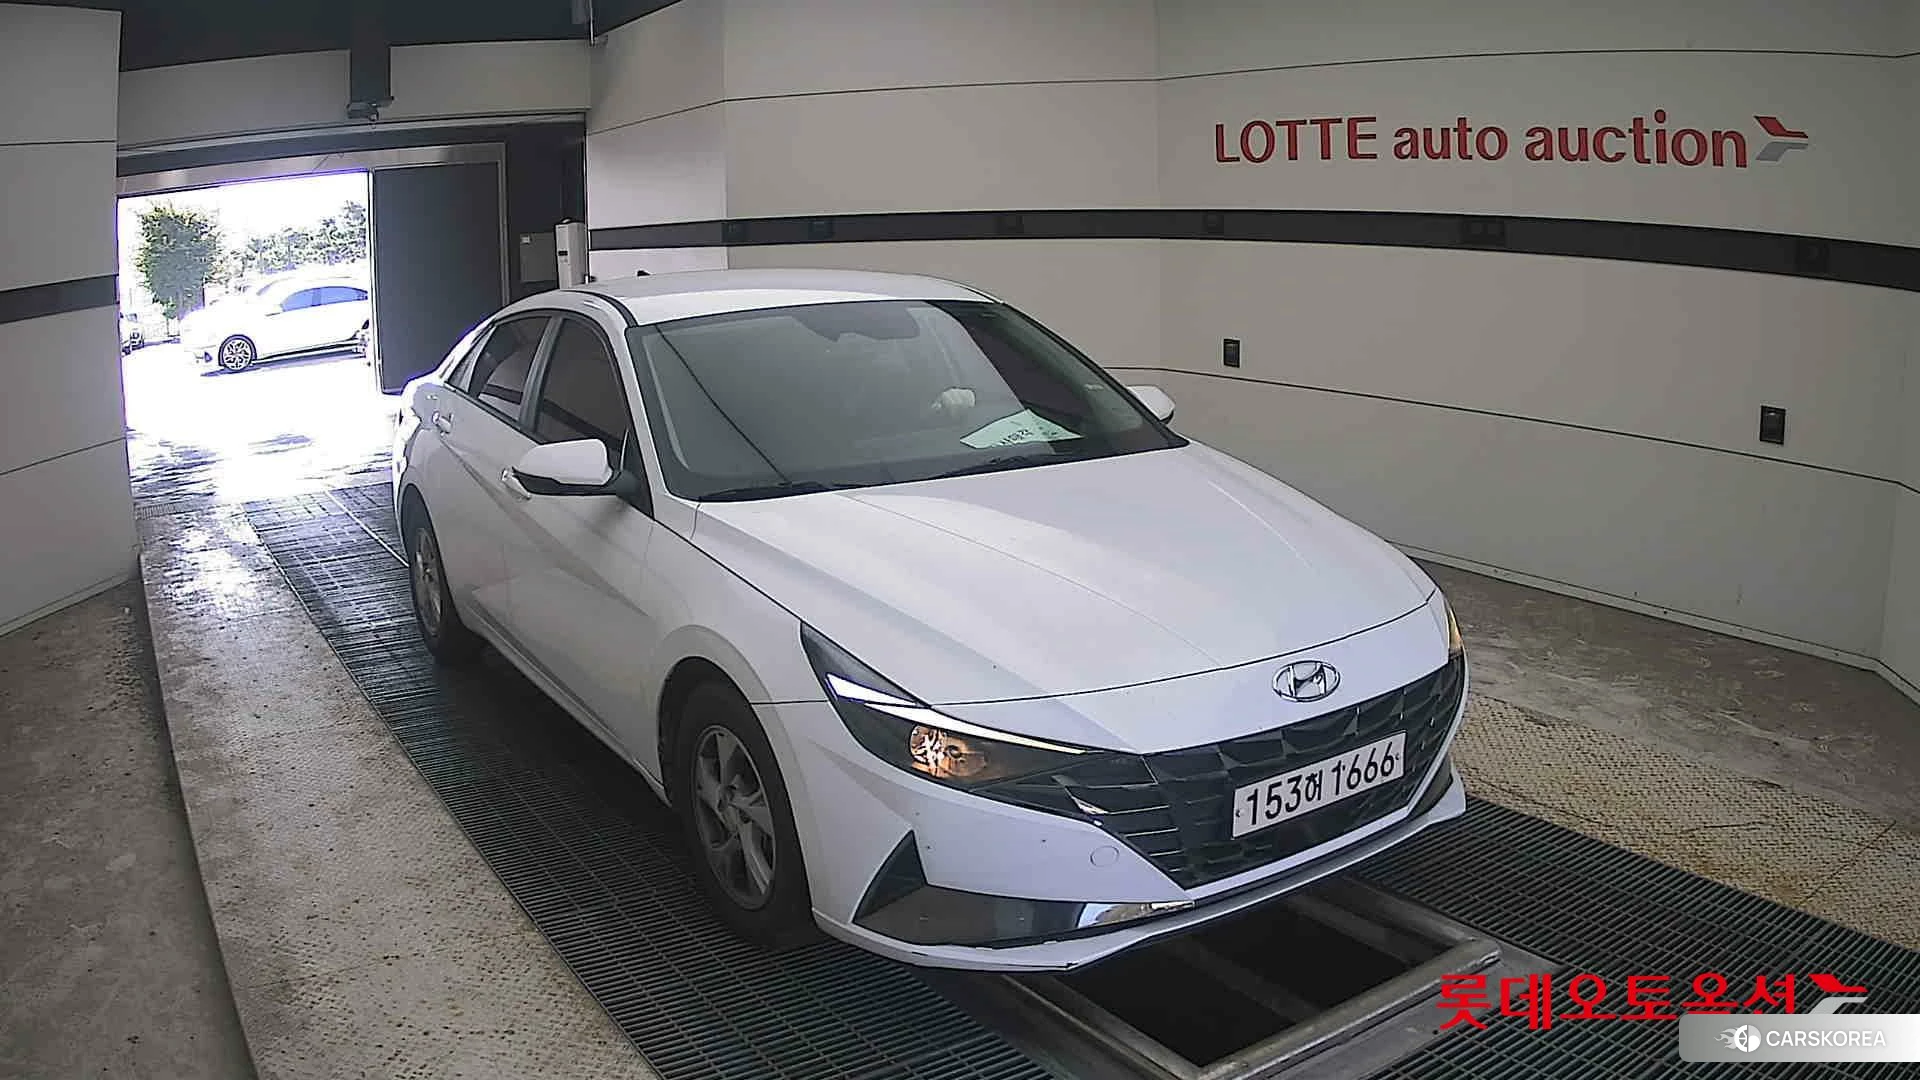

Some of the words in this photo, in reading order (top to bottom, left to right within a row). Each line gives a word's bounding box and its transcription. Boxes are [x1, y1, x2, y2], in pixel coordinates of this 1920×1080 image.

[1214, 116, 1377, 163] LOTTE
[1393, 117, 1509, 162] auto
[1525, 109, 1748, 168] auction
[1247, 769, 1323, 826] 153허
[1331, 741, 1395, 796] 1666
